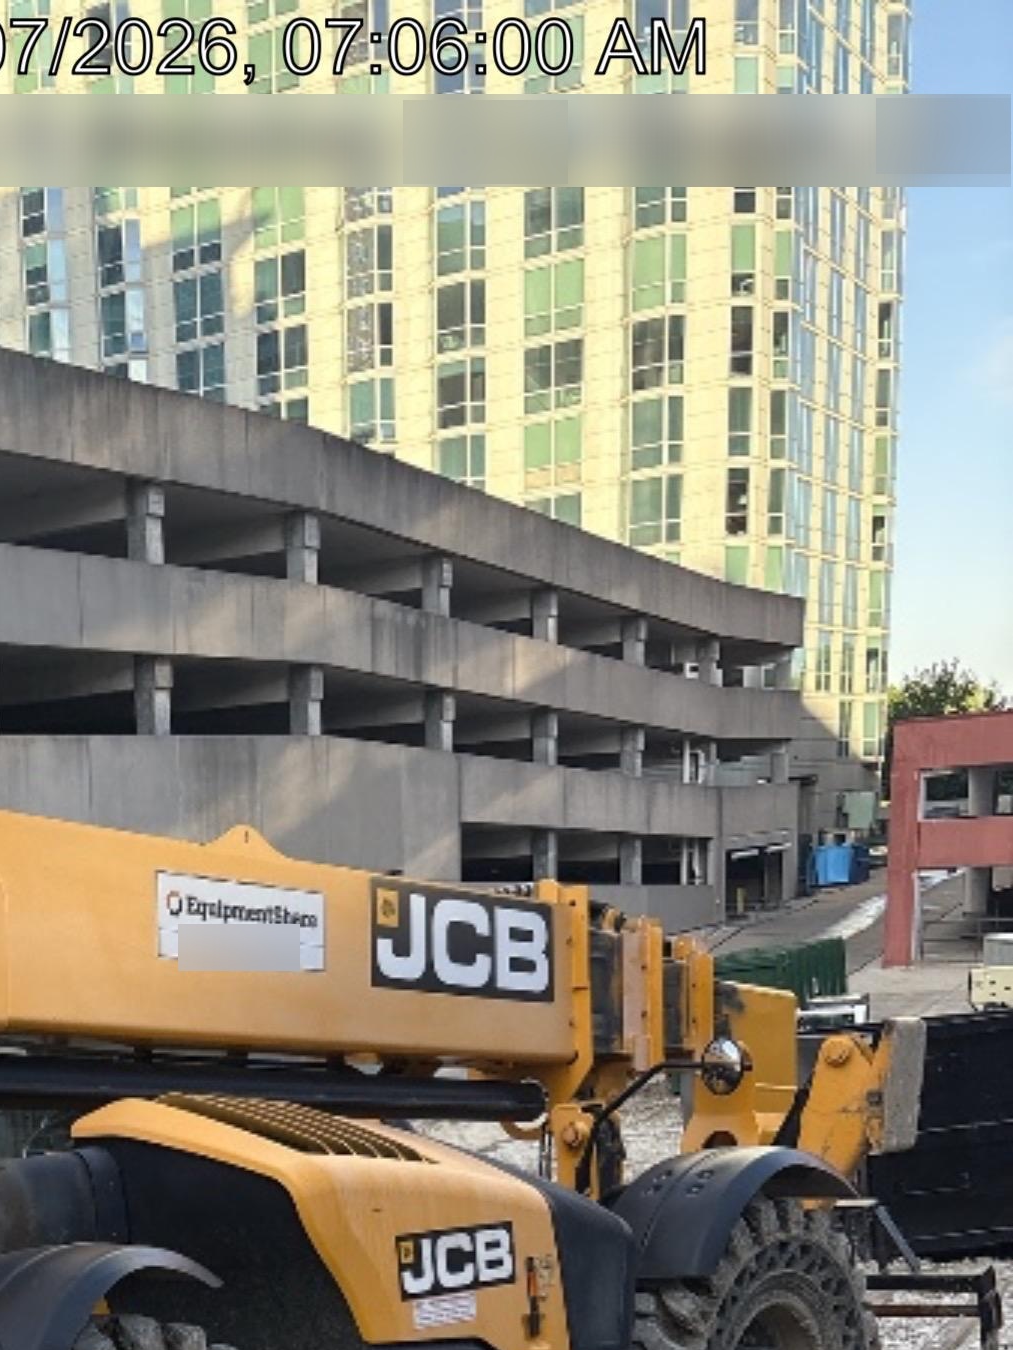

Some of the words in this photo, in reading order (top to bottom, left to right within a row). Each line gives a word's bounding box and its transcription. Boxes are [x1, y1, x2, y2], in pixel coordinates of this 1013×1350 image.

[185, 894, 318, 928] EquipmentShare
[376, 893, 550, 993] JCB
[401, 1228, 514, 1294] JCB
